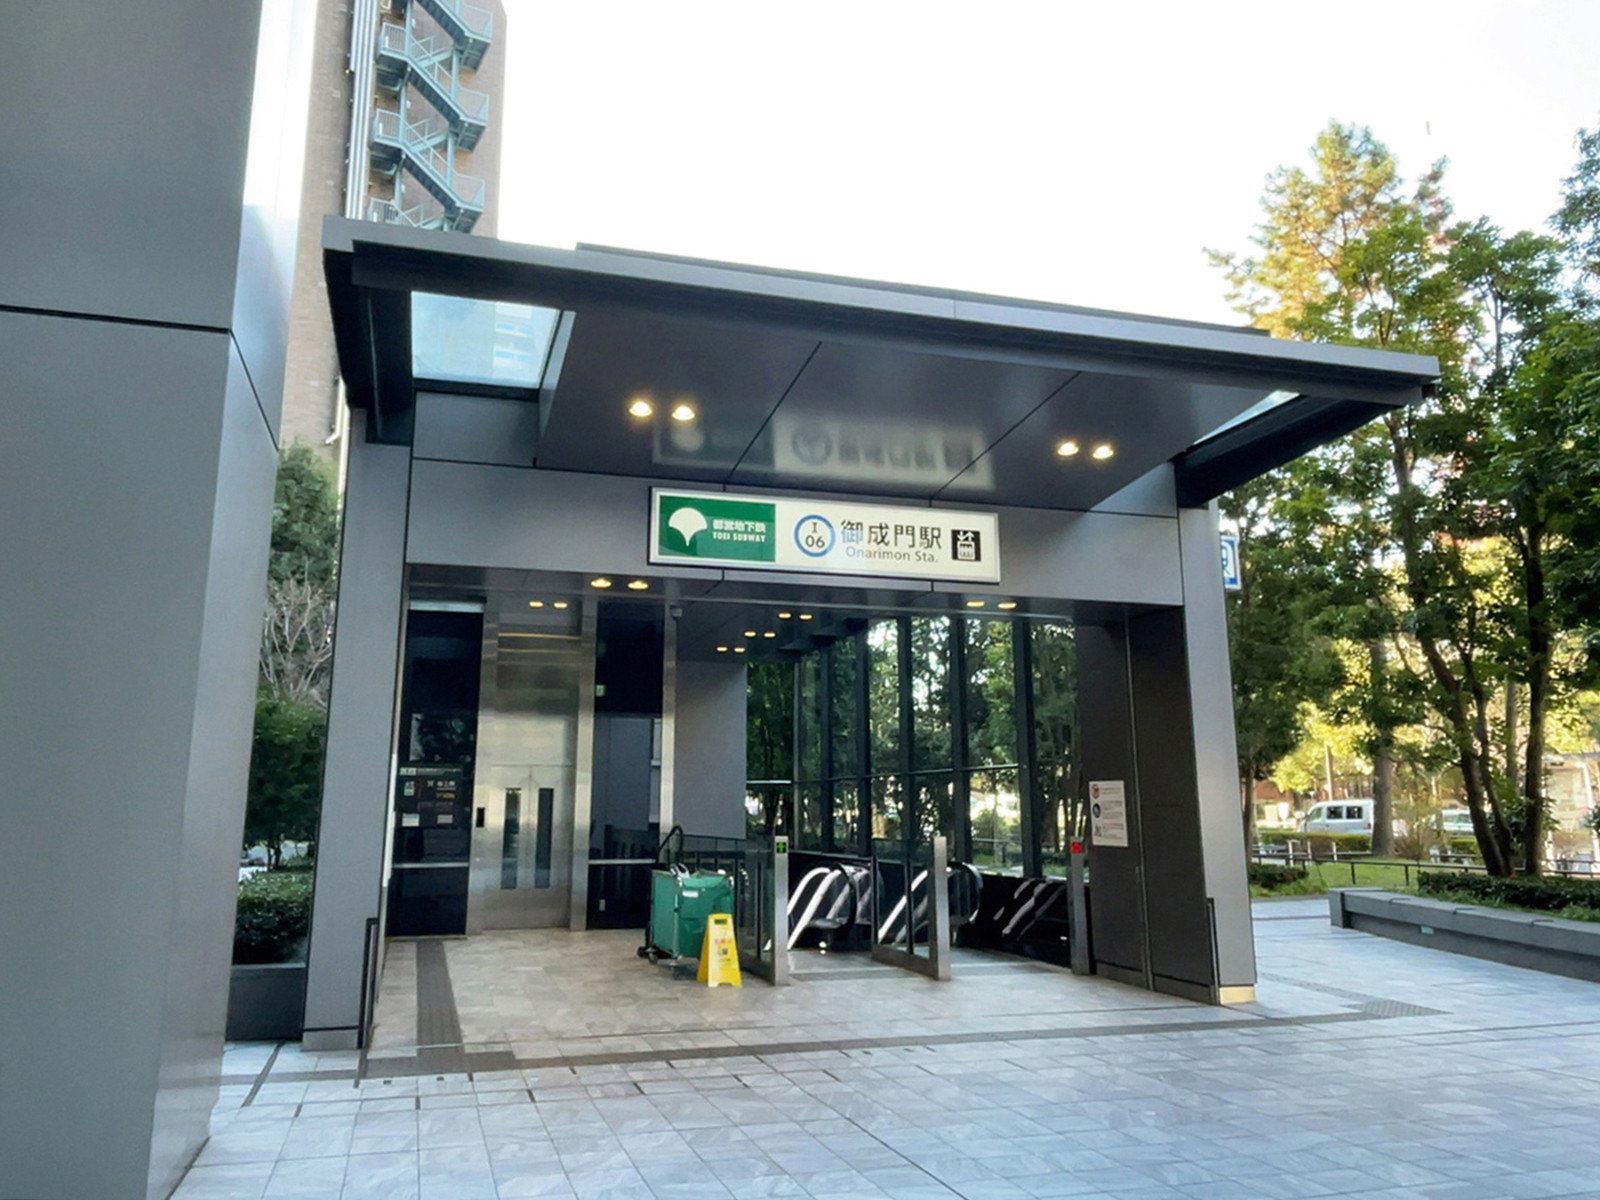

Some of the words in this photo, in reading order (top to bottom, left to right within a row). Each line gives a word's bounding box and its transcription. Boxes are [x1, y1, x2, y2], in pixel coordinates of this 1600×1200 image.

[811, 522, 818, 533] I
[841, 520, 942, 549] 御成門駅
[733, 533, 766, 542] SUBWAY
[805, 535, 825, 549] 06
[846, 546, 911, 561] Onarimon
[915, 551, 938, 563] Sta.
